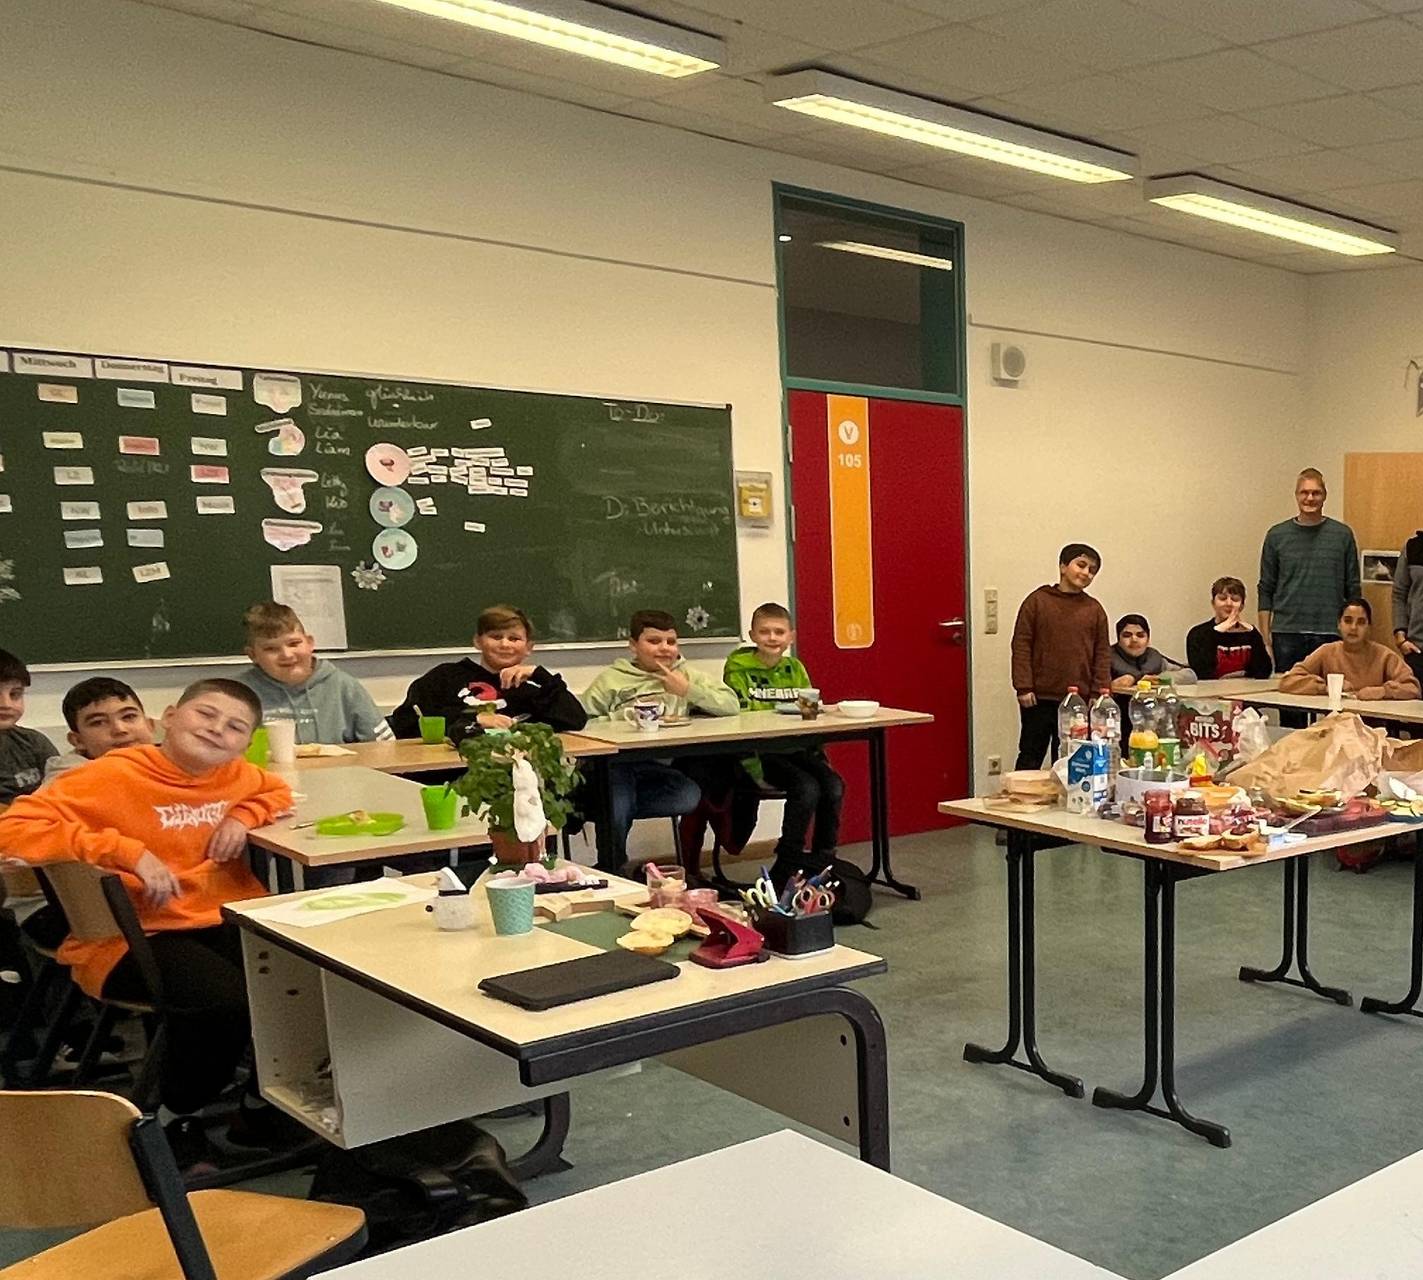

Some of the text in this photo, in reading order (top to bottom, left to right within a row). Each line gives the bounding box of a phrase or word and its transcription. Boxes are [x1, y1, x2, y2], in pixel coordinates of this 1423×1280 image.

[843, 425, 854, 440] V
[838, 454, 862, 468] 105
[1190, 722, 1220, 738] BITS
